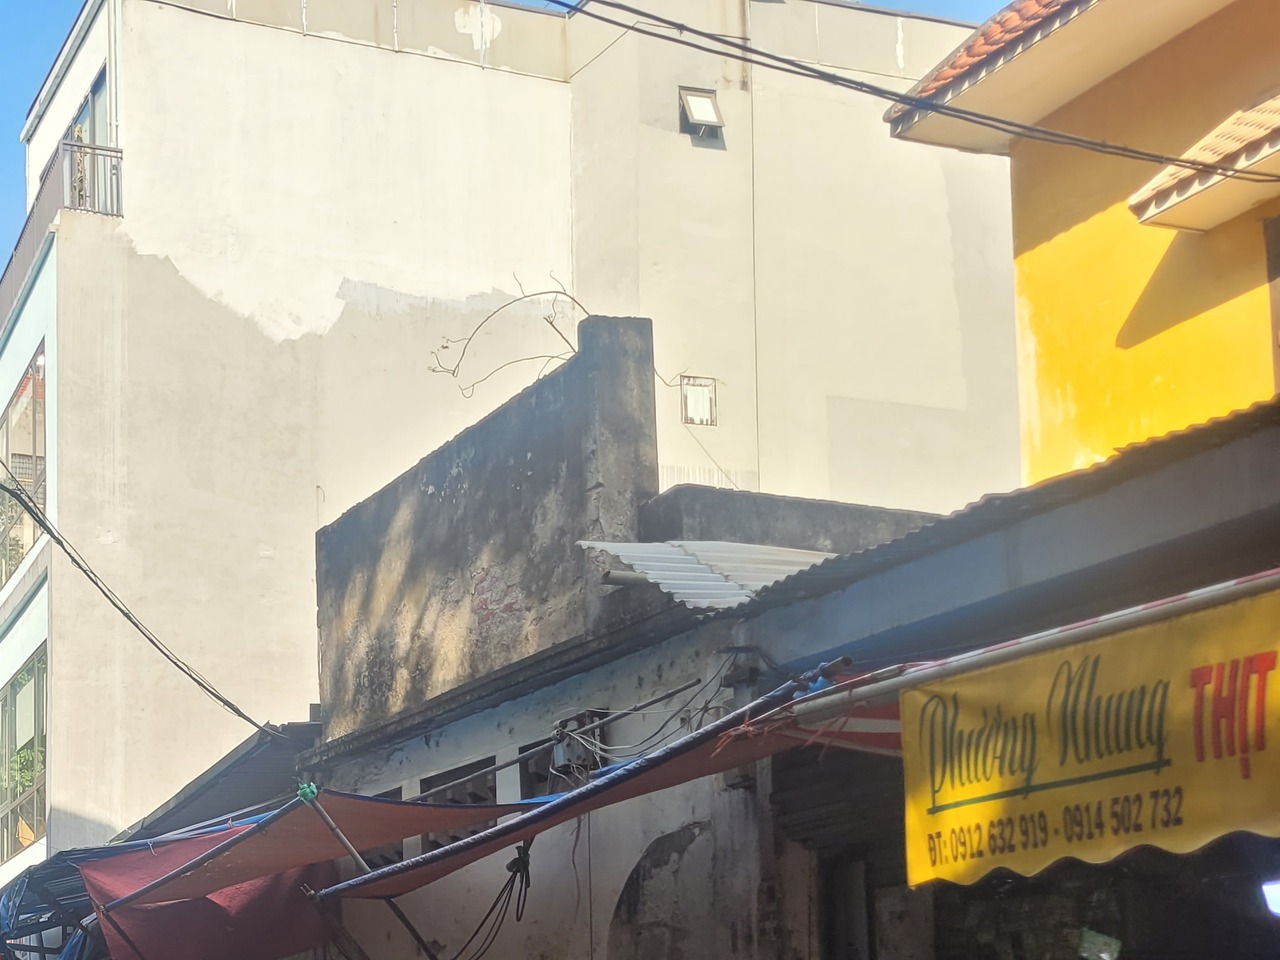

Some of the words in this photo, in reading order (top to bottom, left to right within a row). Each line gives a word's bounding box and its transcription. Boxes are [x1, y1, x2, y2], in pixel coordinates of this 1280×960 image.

[1190, 650, 1277, 780] THỊT
[950, 823, 983, 863] 0912
[988, 817, 1016, 854] 632
[1021, 810, 1049, 850] 919
[1062, 799, 1105, 843] 0914
[1111, 793, 1144, 836] 502
[1150, 786, 1185, 828] 732
